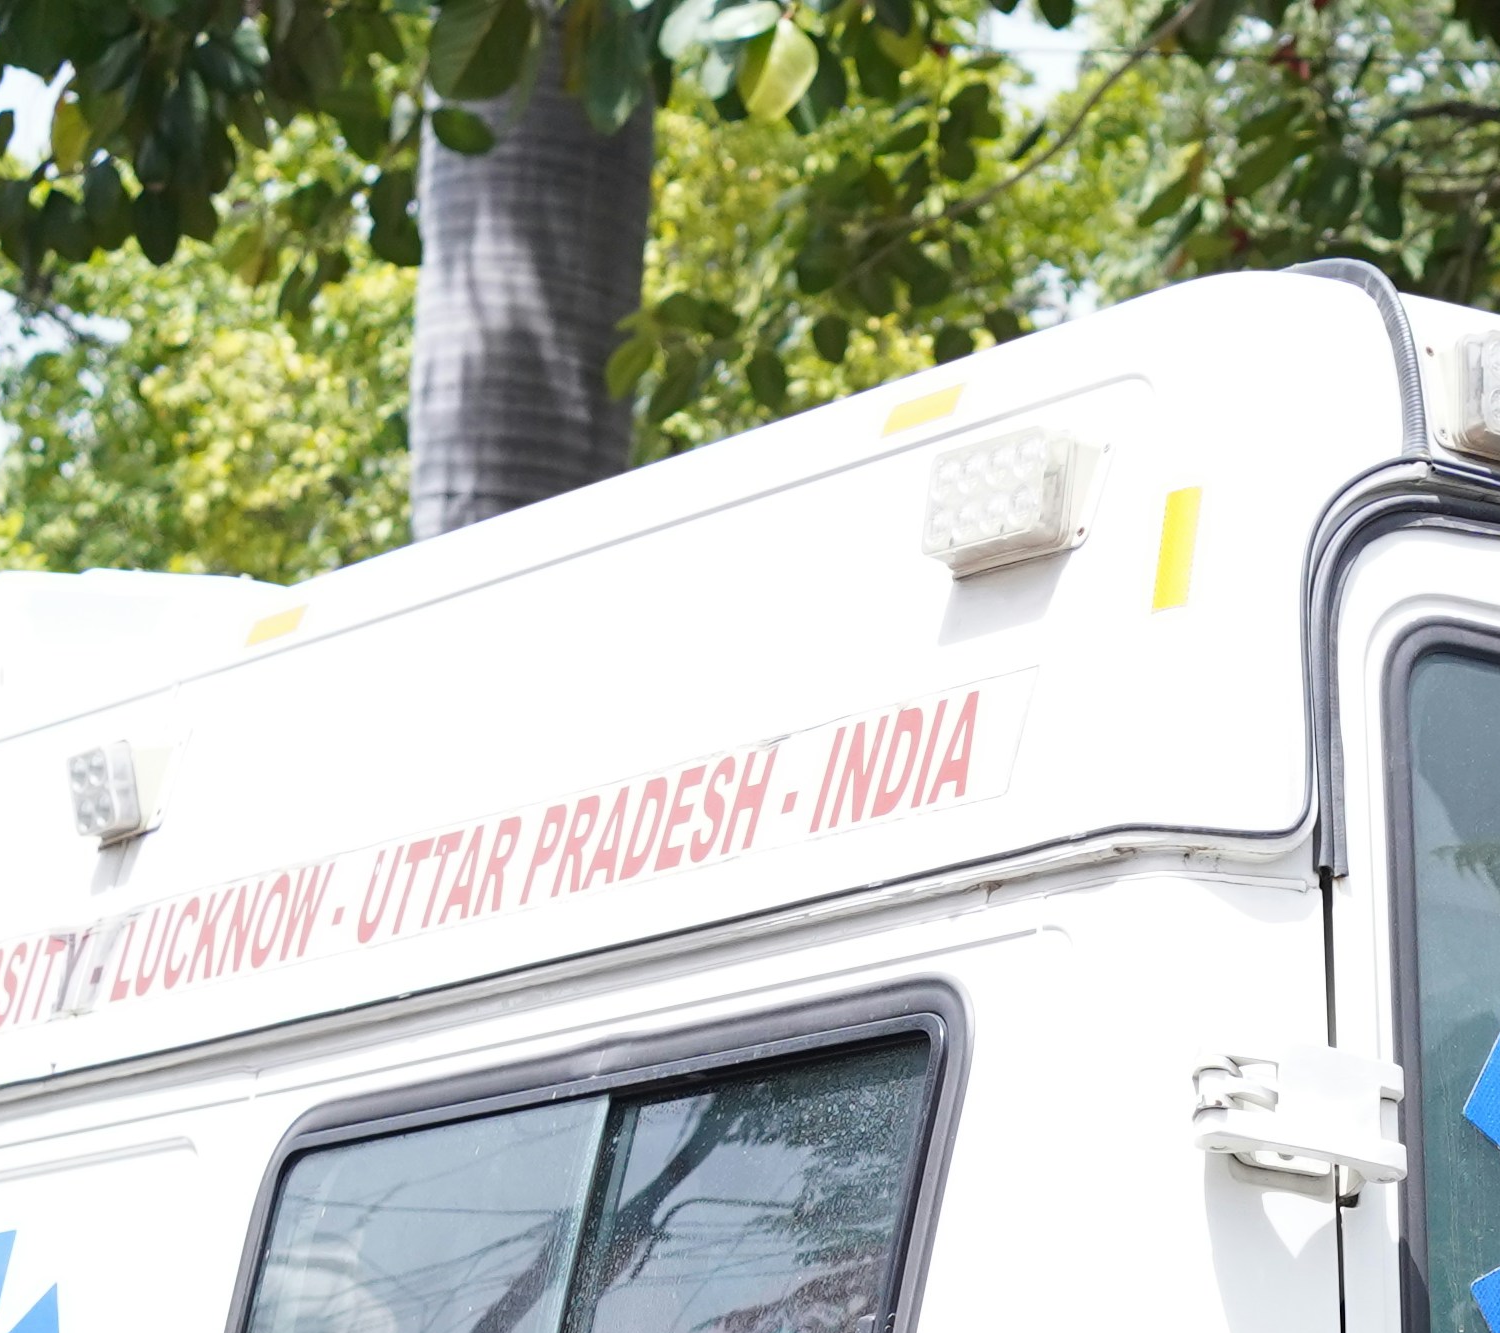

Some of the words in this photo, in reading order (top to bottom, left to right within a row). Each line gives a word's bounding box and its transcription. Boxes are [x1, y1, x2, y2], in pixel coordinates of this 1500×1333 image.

[109, 861, 337, 1003] LUCKNOW
[356, 815, 522, 945] UTTAR
[519, 743, 781, 905] PRADESH
[808, 690, 980, 834] INDIA
